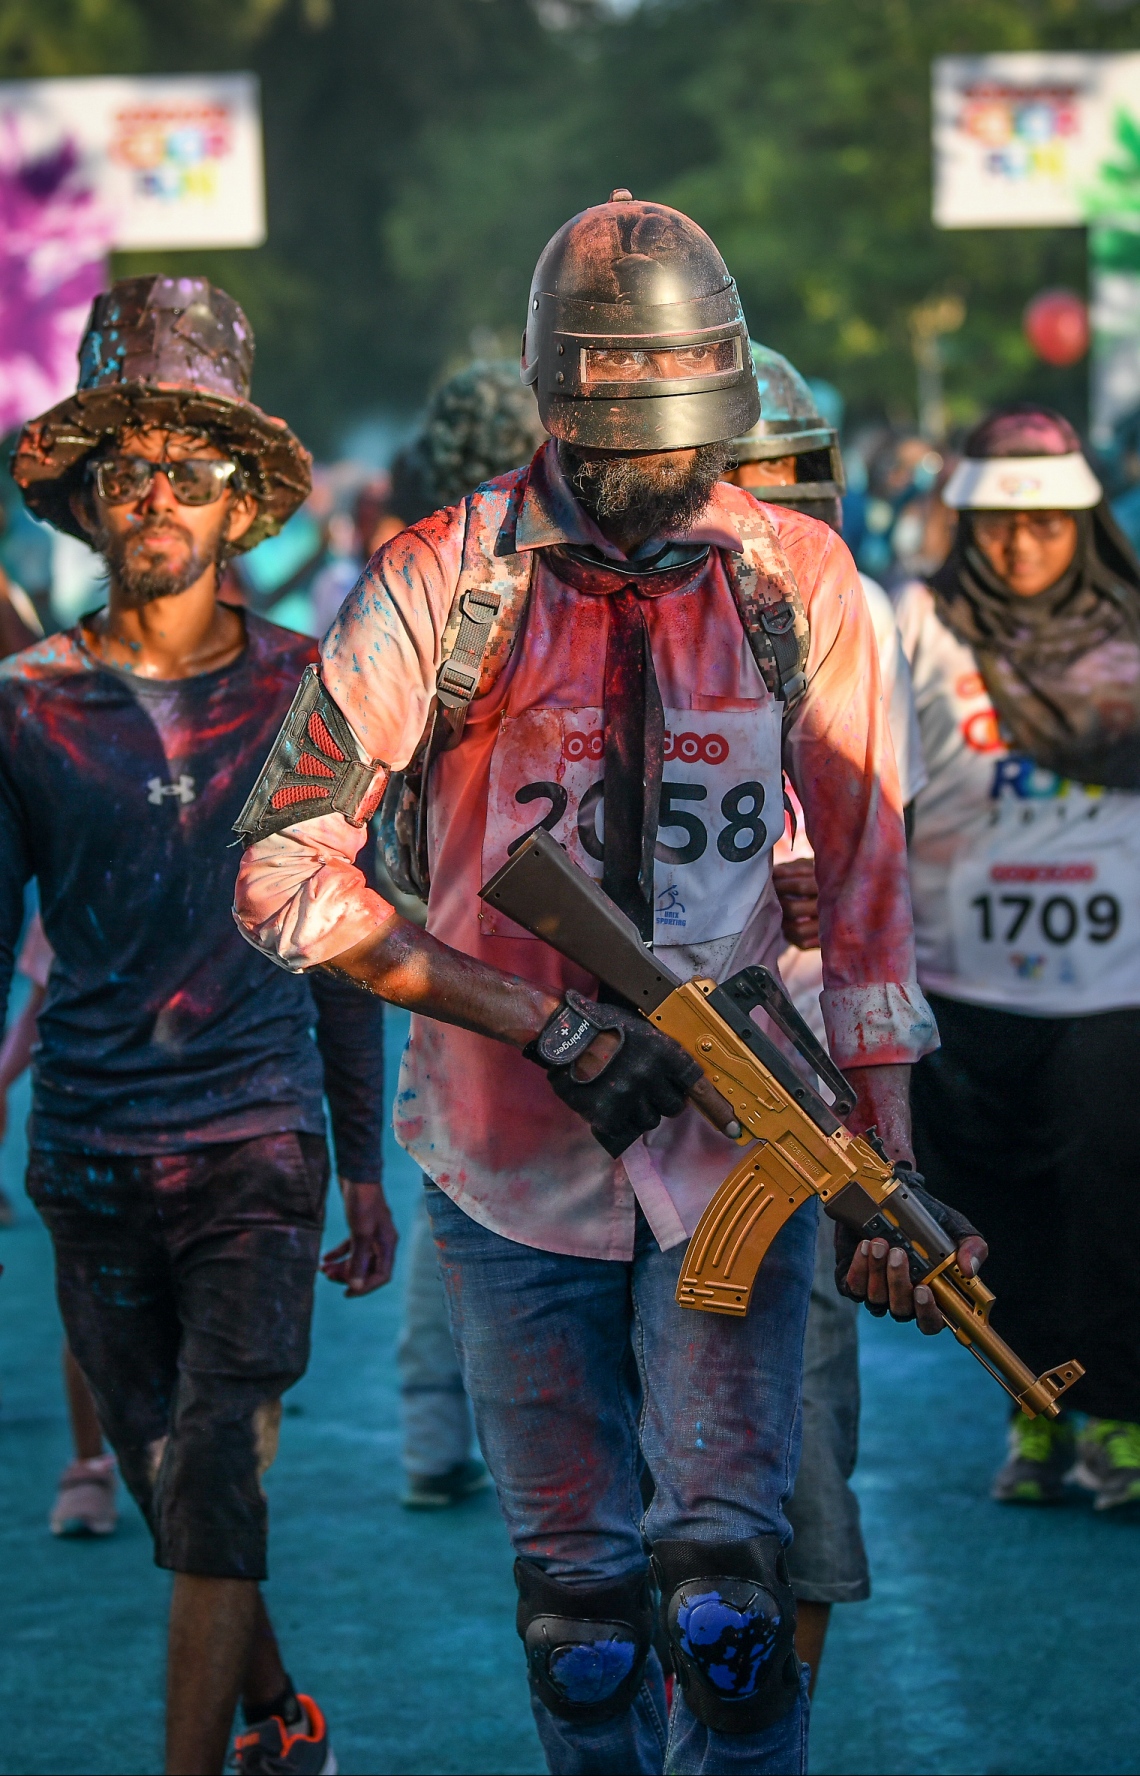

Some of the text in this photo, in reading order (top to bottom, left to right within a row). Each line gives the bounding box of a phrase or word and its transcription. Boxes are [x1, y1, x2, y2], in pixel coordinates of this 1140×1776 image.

[564, 731, 728, 764] oodoo
[656, 918, 686, 926] SPORTING
[972, 893, 1121, 945] 1709
